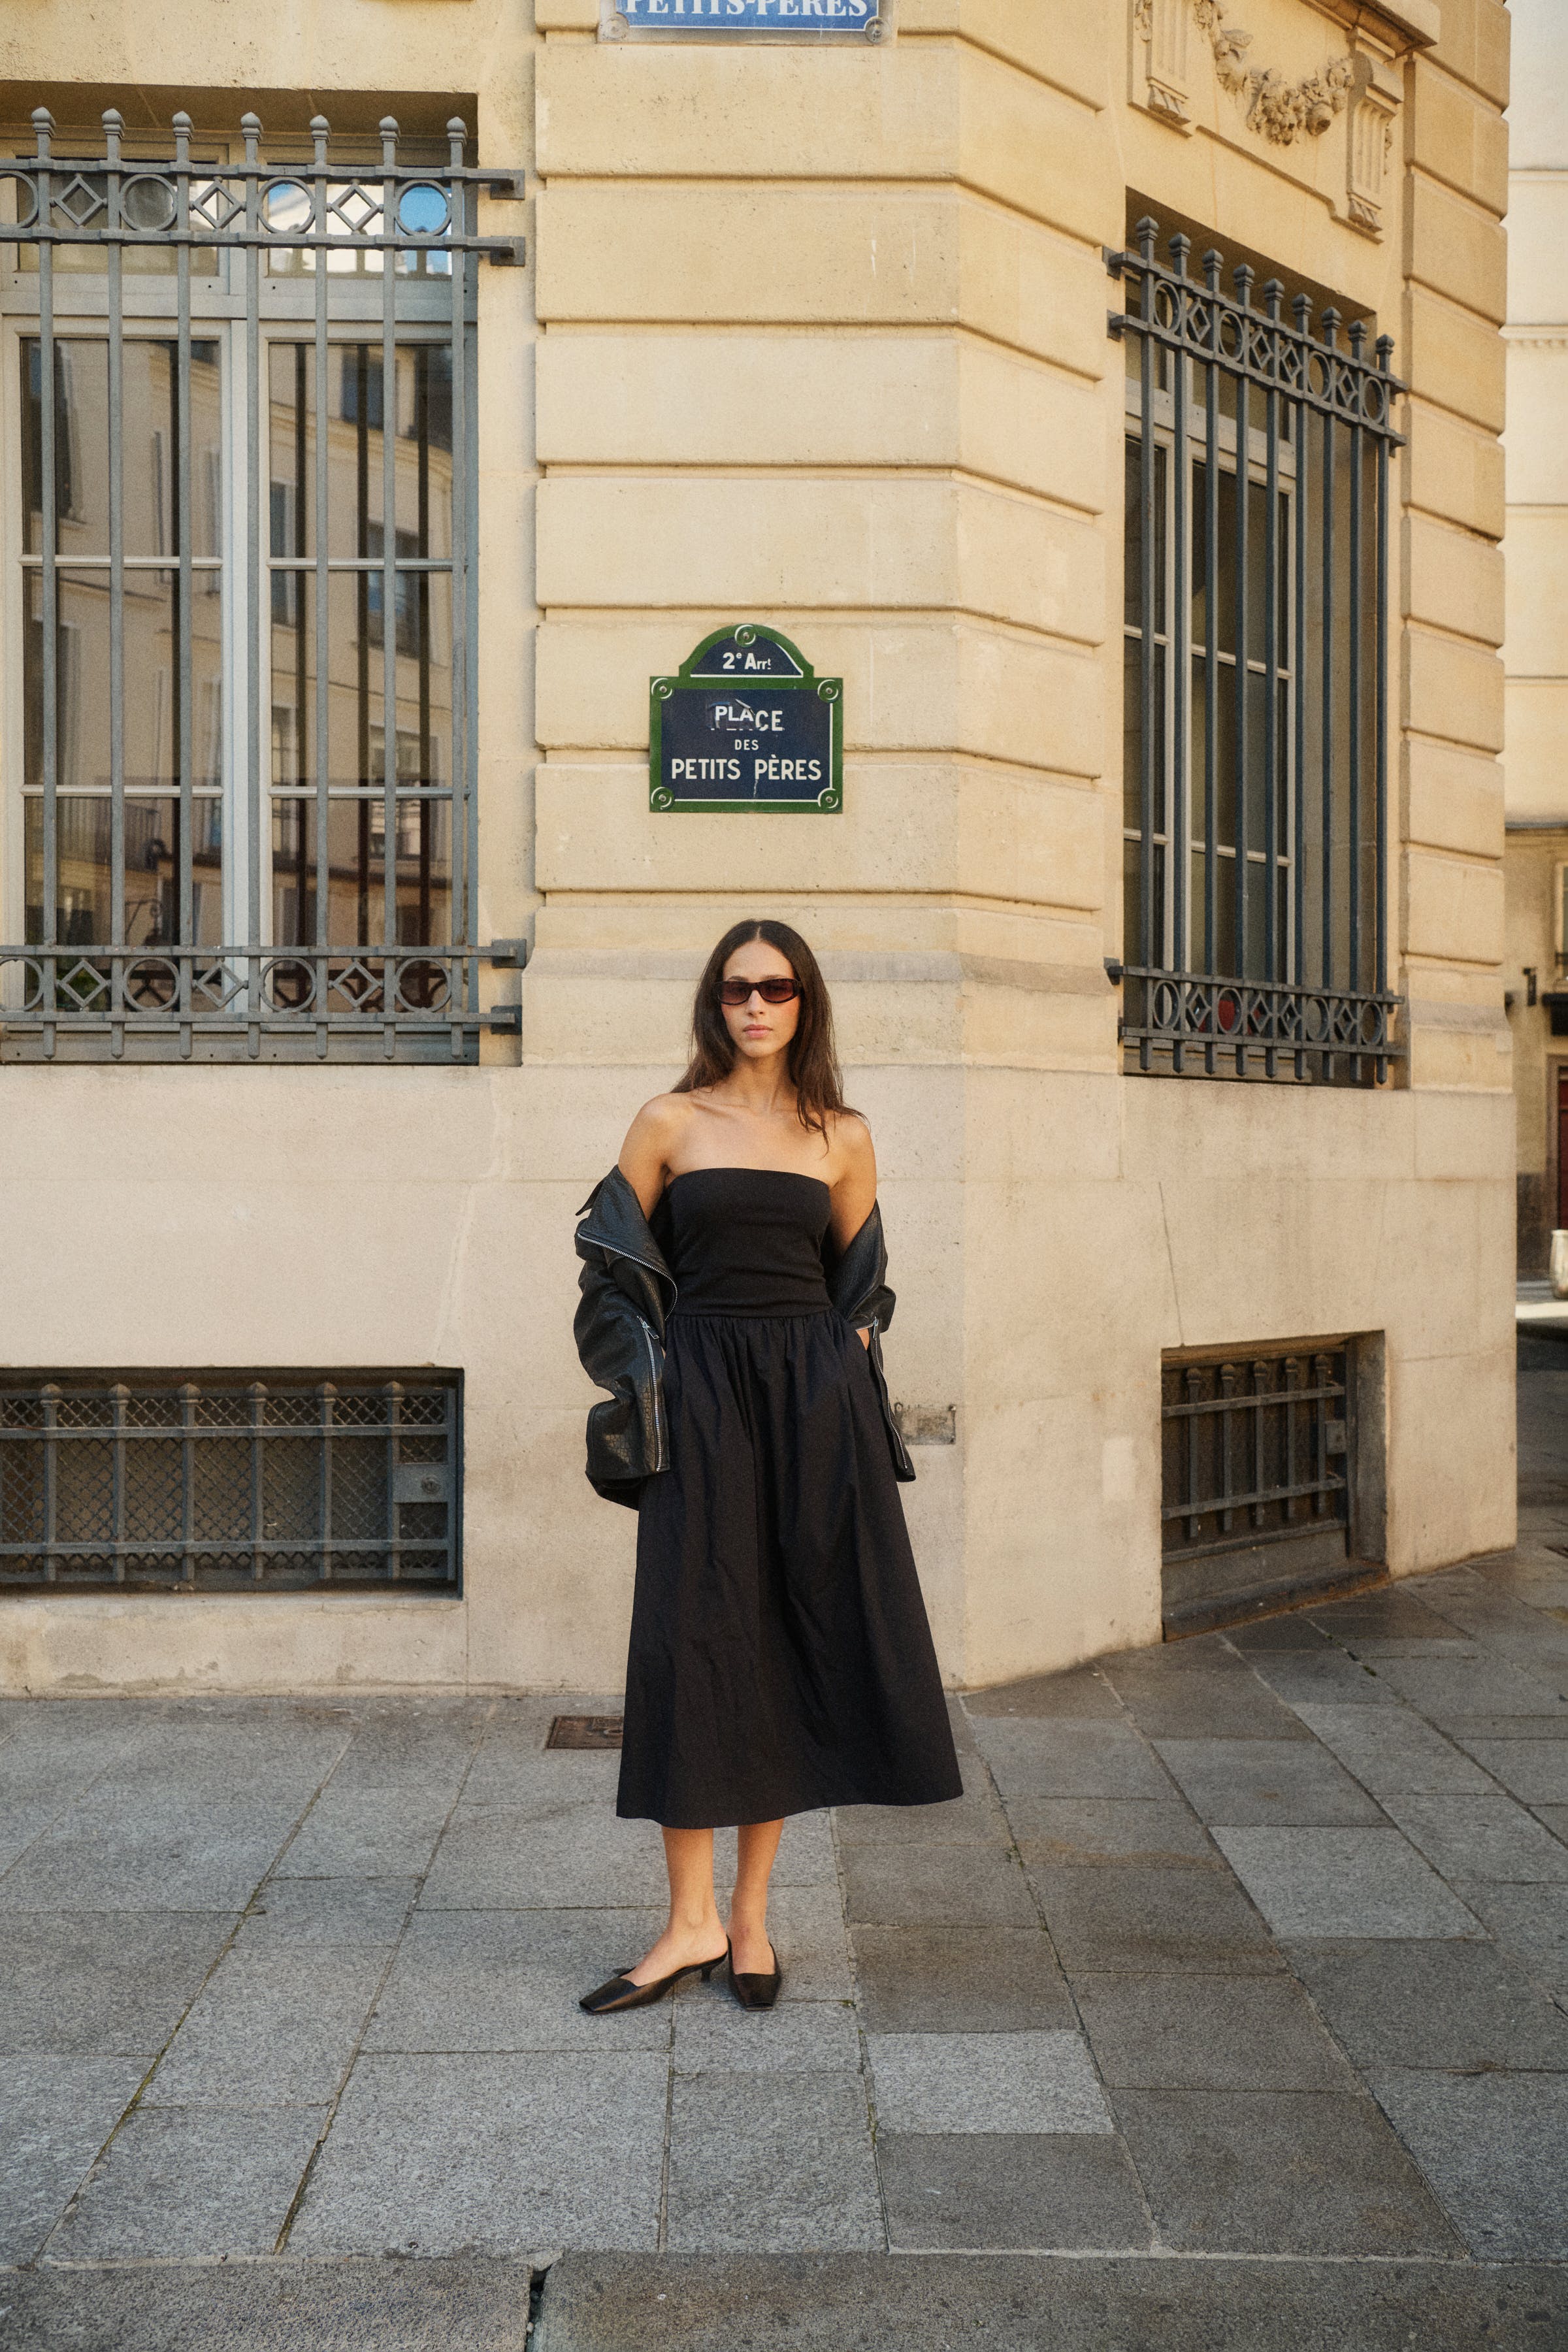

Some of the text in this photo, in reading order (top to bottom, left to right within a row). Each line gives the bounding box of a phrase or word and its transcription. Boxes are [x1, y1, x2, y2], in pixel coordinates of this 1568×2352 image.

[715, 706, 783, 731] PLACE
[734, 739, 759, 751] DES
[672, 754, 822, 781] PETITS PÈRES
